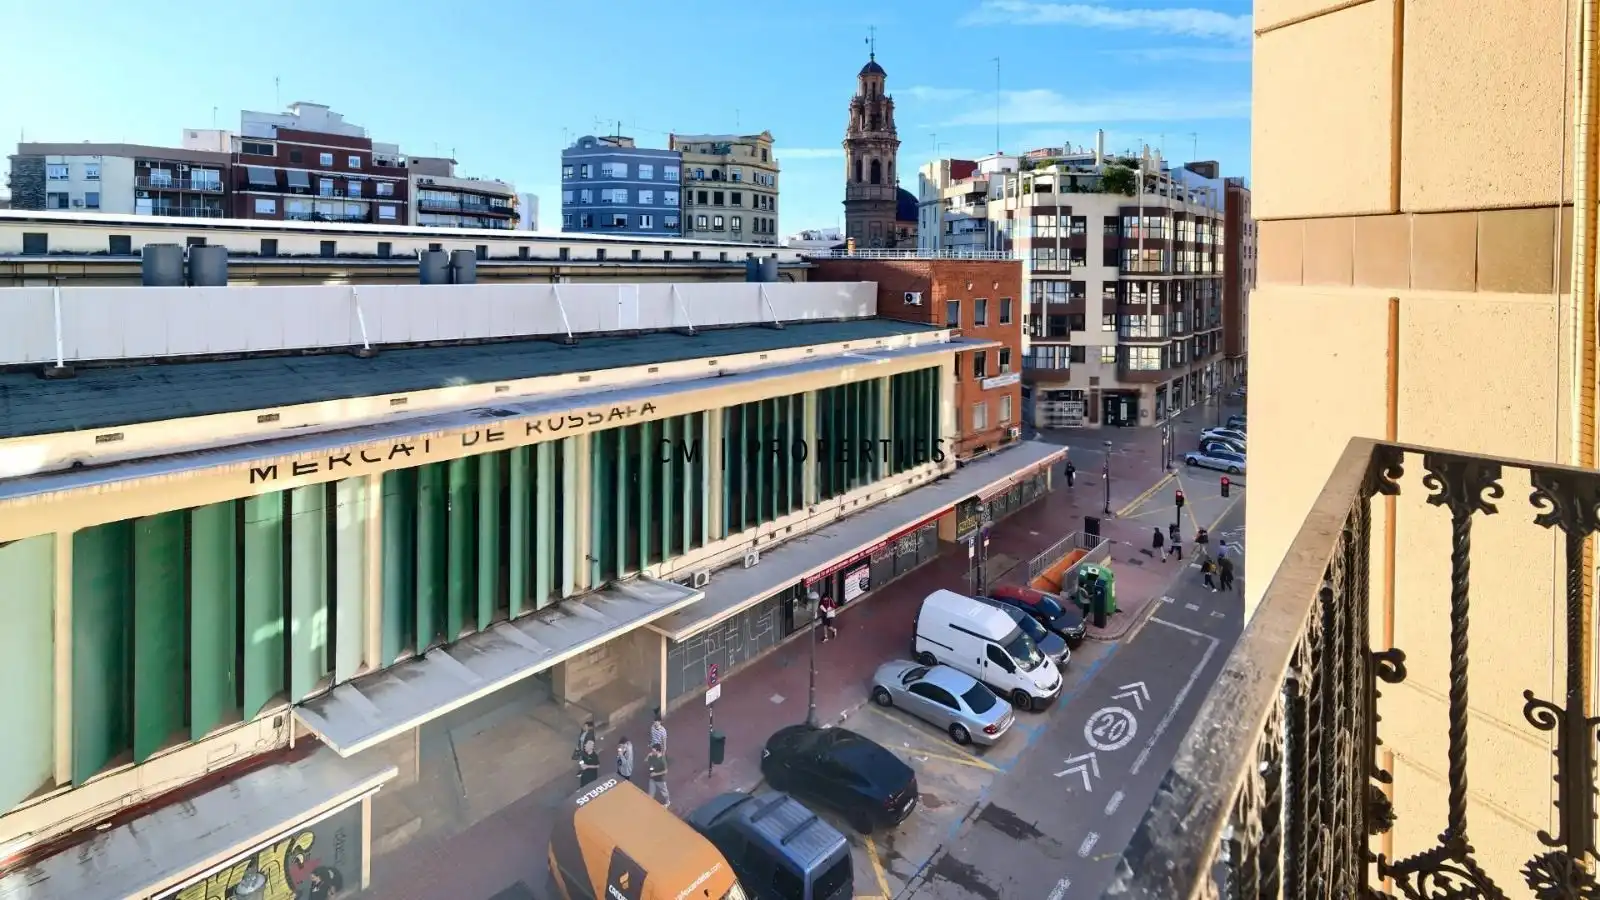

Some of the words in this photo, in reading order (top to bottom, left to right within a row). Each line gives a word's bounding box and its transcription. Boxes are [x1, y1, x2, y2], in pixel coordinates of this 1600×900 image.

[462, 428, 505, 447] DE
[1093, 713, 1127, 742] 20
[576, 778, 617, 806] CANDELAS
